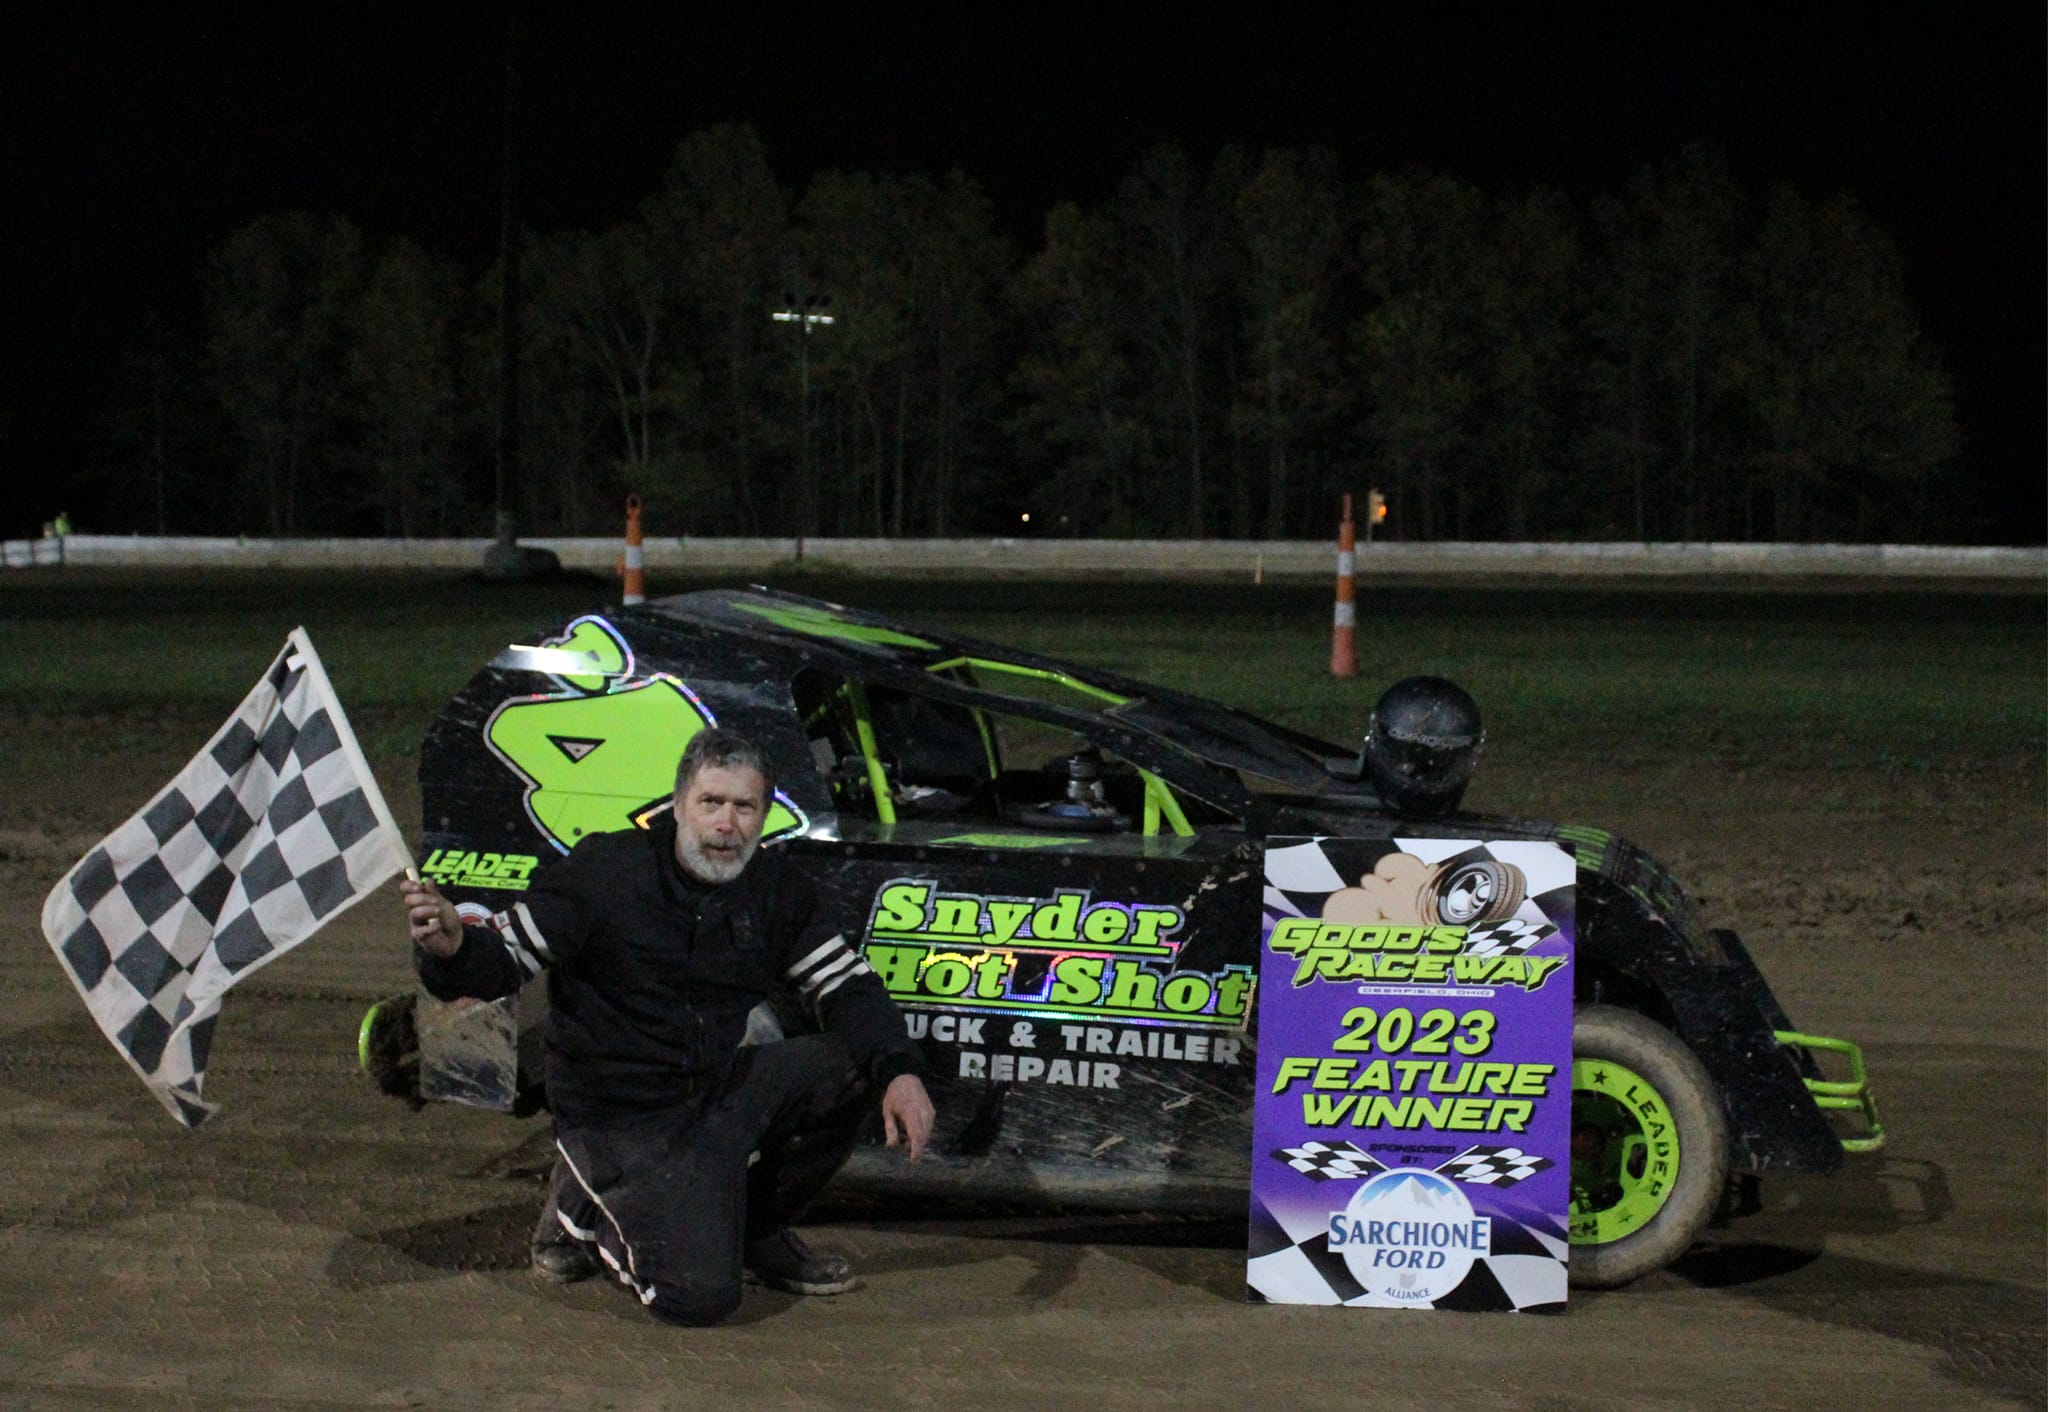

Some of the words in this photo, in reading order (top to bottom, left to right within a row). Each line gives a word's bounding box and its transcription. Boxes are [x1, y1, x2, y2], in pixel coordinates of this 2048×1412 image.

[420, 849, 539, 879] LEADER
[874, 885, 1178, 944] Snyder
[1270, 919, 1467, 954] GOOD'S
[866, 945, 1006, 998] Hot
[1050, 956, 1250, 1015] Shot
[1295, 948, 1566, 990] RACEWAY
[904, 1013, 987, 1044] UCK
[1009, 1021, 1037, 1048] &
[1061, 1025, 1241, 1065] TRAILER
[1333, 1007, 1498, 1055] 2023
[959, 1051, 1121, 1089] REPAIR
[1272, 1057, 1555, 1096] FEATURE
[1302, 1094, 1534, 1132] WINNER
[1368, 1143, 1457, 1154] SPONSORED
[1329, 1214, 1488, 1250] SARCHIONE
[1373, 1249, 1446, 1269] FORD
[1384, 1286, 1432, 1300] ALLIANCE
